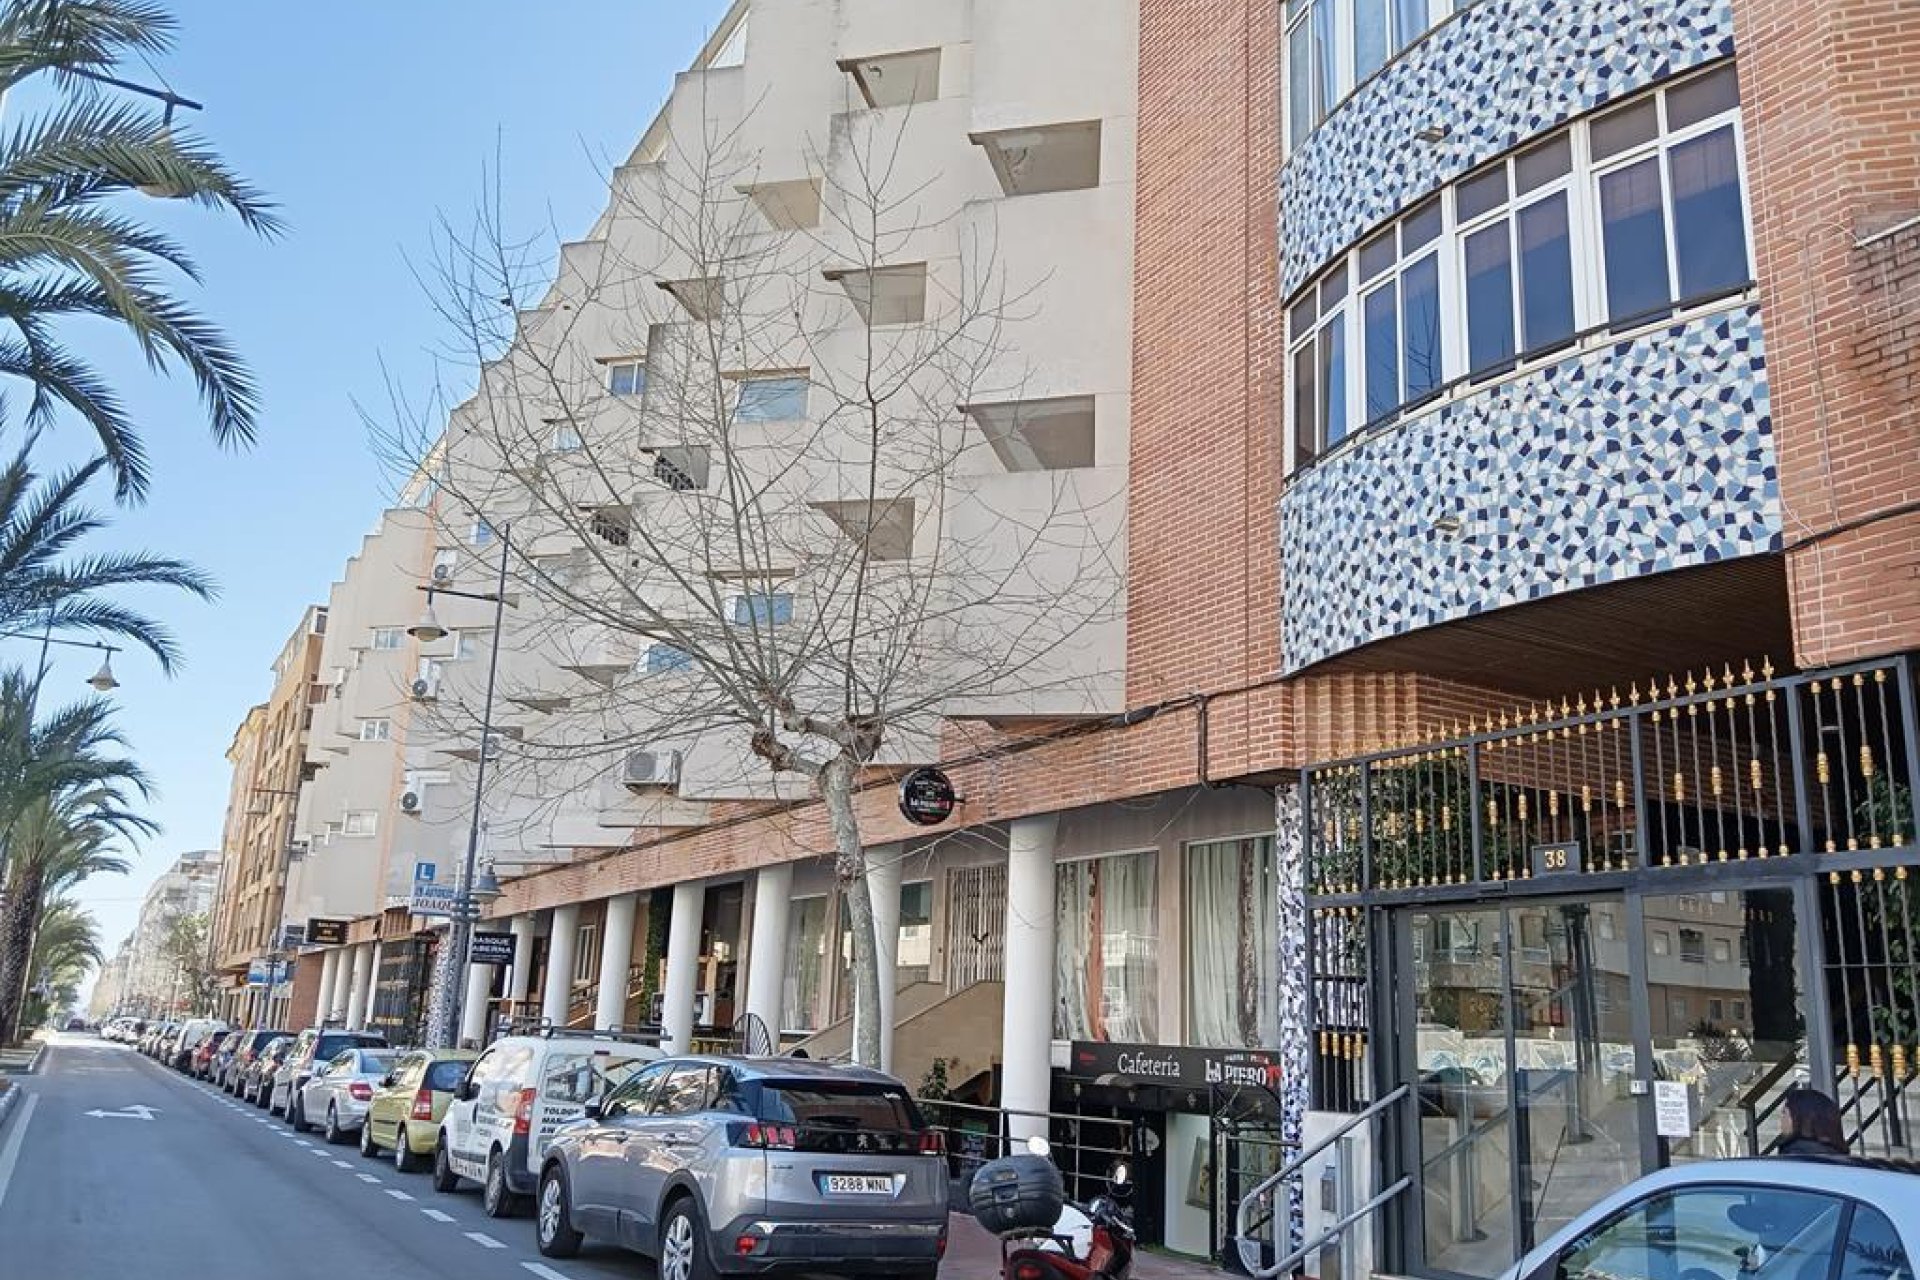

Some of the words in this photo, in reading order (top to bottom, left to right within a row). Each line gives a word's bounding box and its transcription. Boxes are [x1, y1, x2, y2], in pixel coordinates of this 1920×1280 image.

[1544, 849, 1566, 869] 38
[1117, 1052, 1181, 1078] Cafetería
[830, 1177, 863, 1192] 9288
